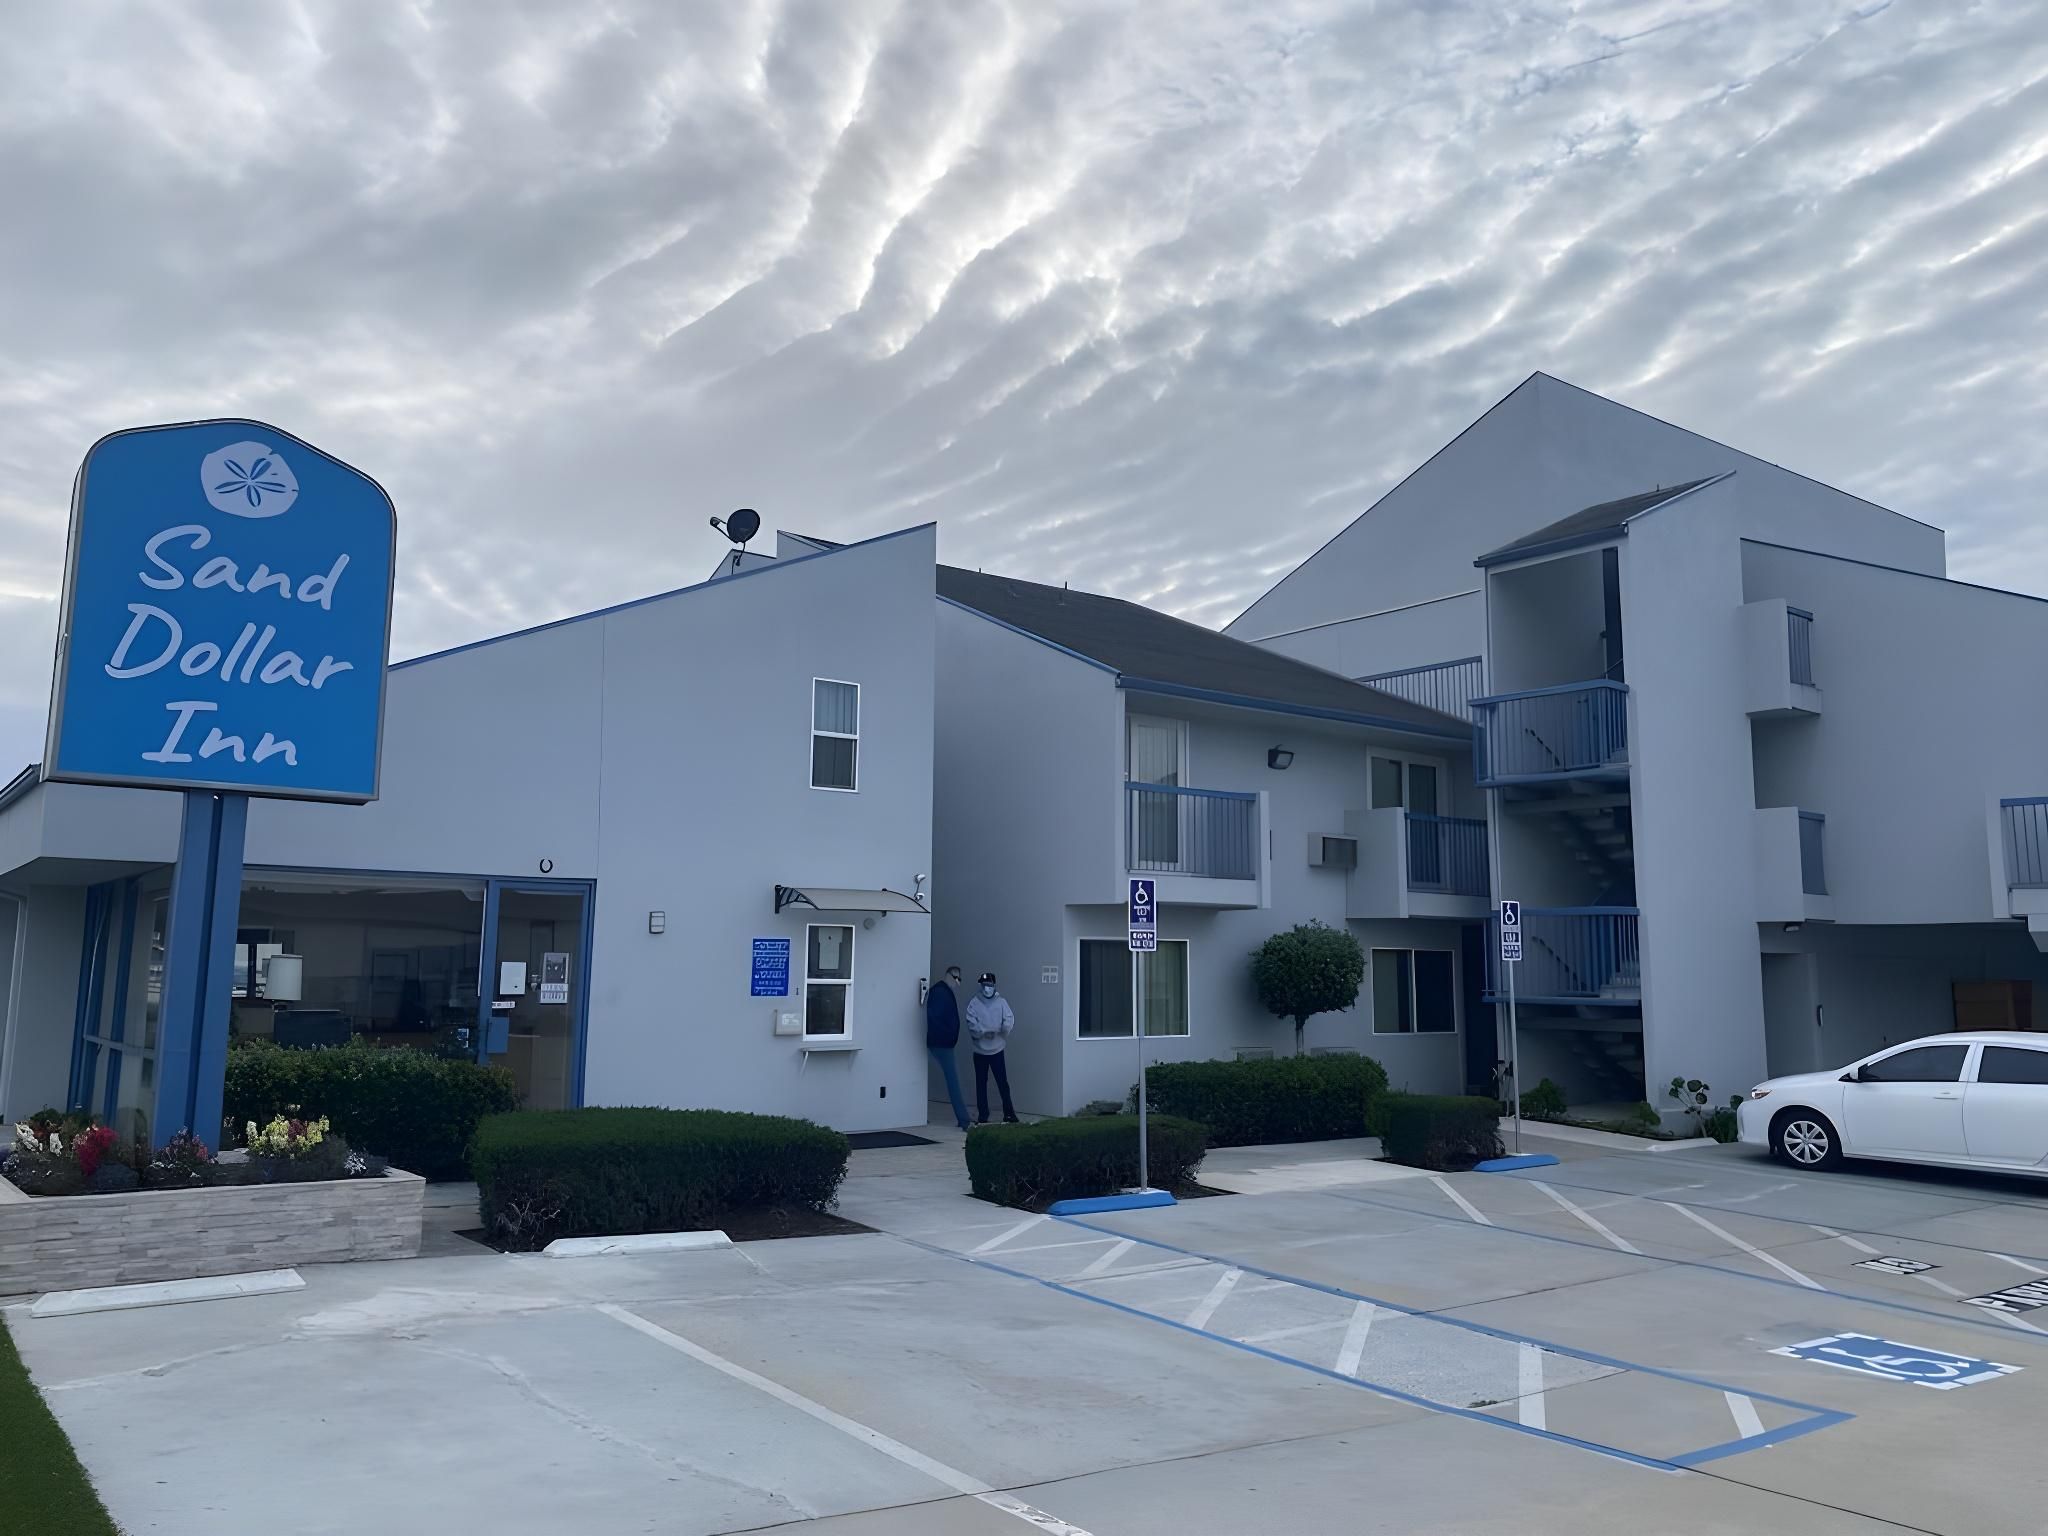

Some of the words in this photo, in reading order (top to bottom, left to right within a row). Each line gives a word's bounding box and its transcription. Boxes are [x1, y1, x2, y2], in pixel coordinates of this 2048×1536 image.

[139, 524, 350, 611] Sand
[104, 603, 354, 690] Dollar
[141, 700, 298, 766] Inn
